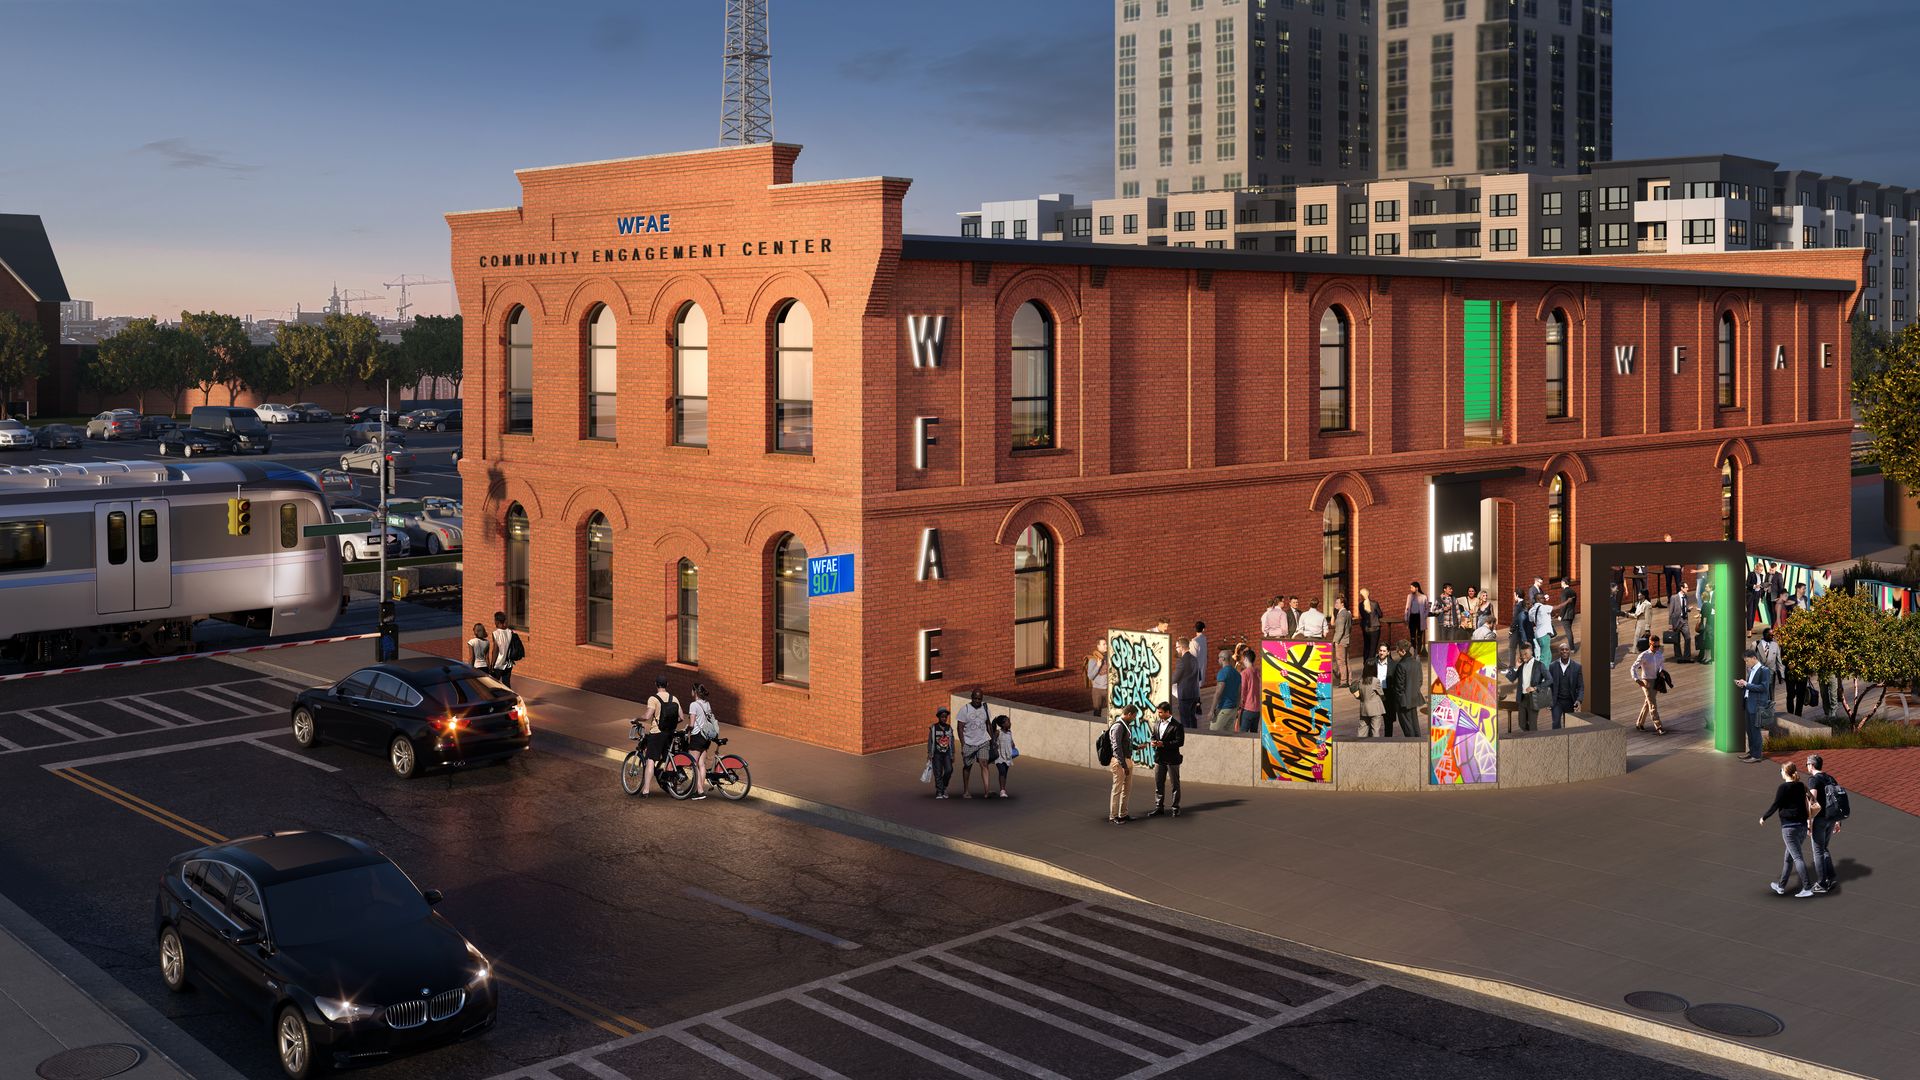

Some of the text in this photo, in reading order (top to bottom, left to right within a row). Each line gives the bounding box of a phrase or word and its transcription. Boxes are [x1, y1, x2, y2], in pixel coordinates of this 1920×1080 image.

[617, 213, 670, 234] WFAE
[479, 238, 832, 268] COMMUNITY ENGAGEMENT CENTER
[1443, 532, 1473, 553] WFAE
[812, 558, 838, 574] WFAE
[813, 572, 838, 594] 90.7
[1110, 635, 1161, 678] SPREAD
[1112, 683, 1157, 713] SPEAK
[1119, 667, 1151, 704] LOVE
